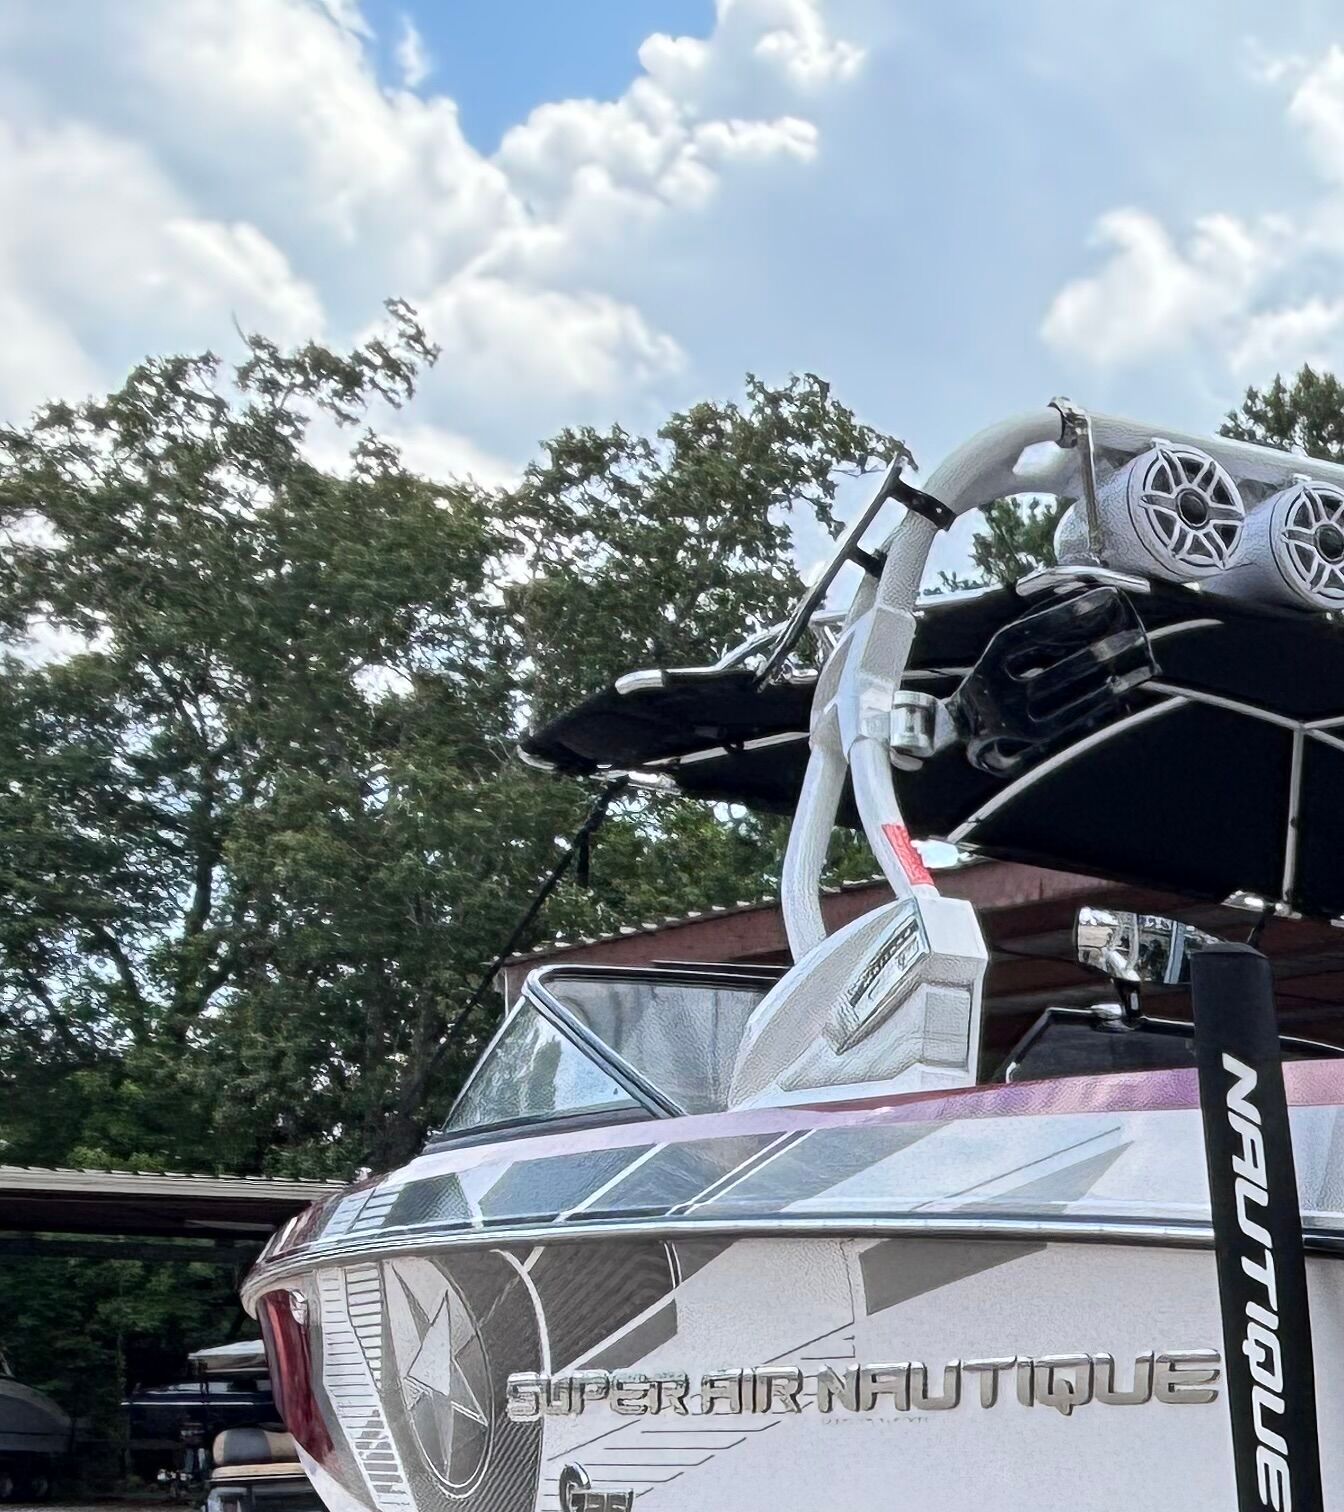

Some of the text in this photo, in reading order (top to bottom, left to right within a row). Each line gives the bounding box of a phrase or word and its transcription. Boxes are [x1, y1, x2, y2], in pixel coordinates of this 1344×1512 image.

[505, 1347, 1221, 1422] SUPER AIR NAUTIQUE
